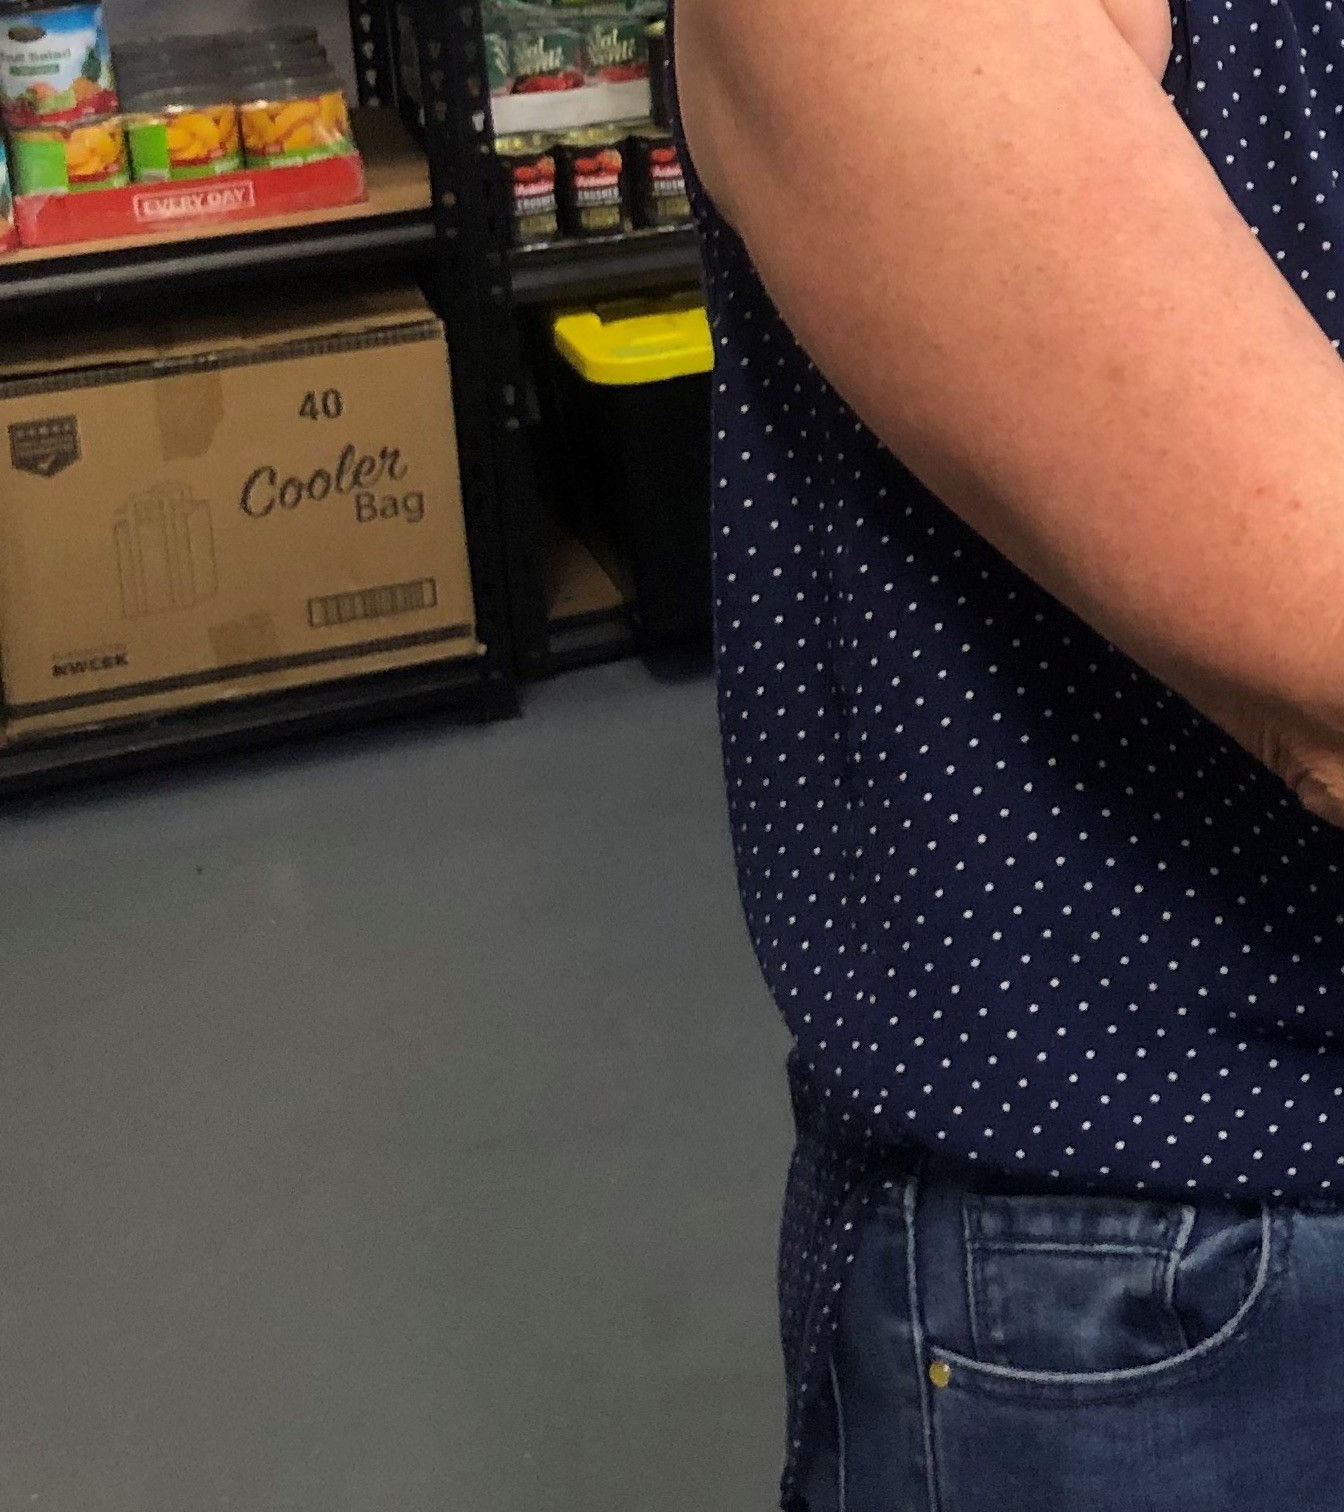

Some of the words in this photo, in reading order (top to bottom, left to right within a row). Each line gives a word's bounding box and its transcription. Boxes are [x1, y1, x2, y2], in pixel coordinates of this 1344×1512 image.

[298, 388, 344, 421] 40
[240, 444, 408, 519] Cooler
[354, 490, 425, 524] Bag
